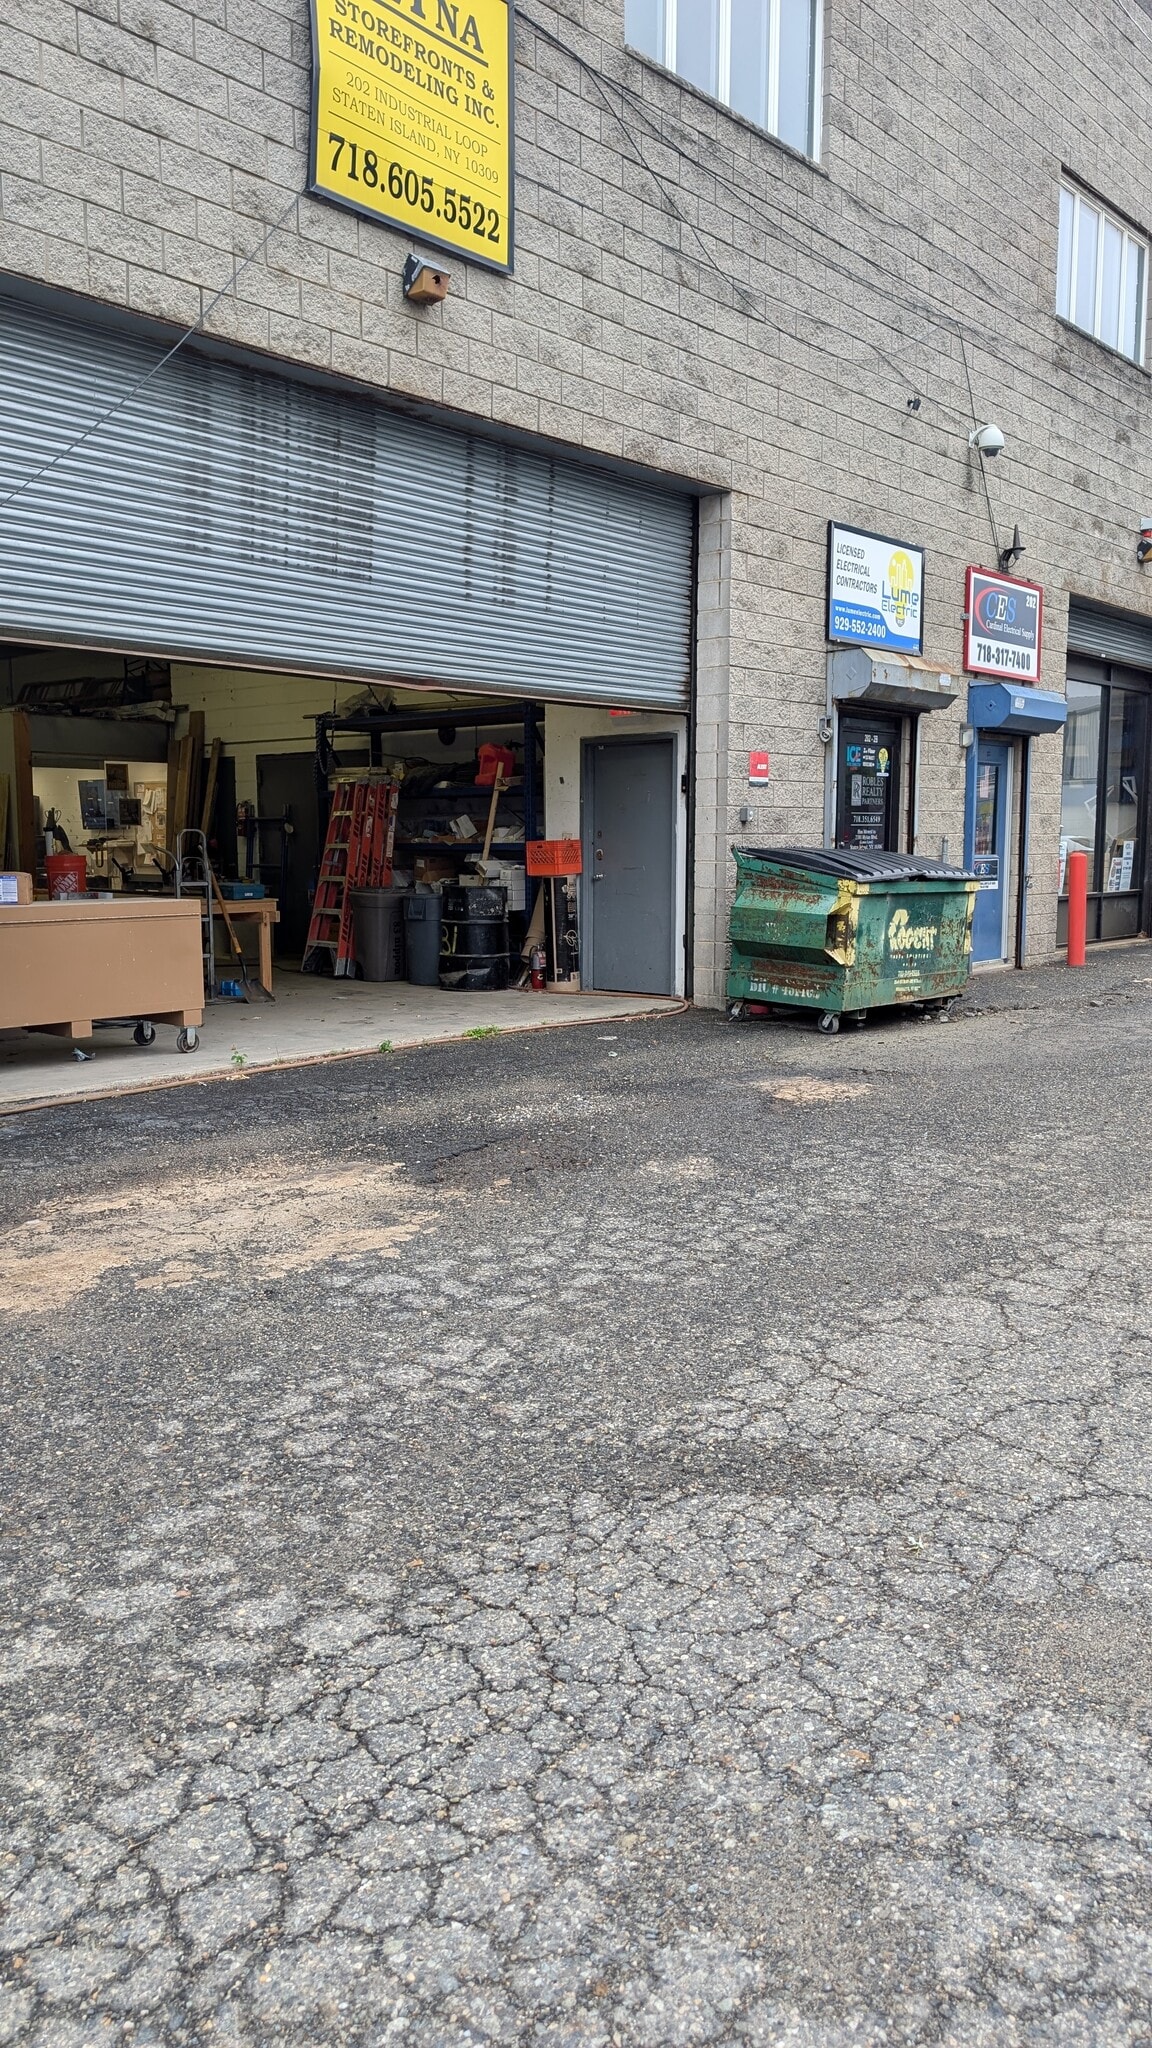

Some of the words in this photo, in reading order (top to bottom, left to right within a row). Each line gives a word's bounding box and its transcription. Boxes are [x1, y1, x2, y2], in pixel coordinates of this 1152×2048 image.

[335, 0, 476, 90] STOREFRONTS
[482, 80, 495, 101] &
[329, 17, 459, 107] REMODELING
[464, 94, 500, 128] INC.
[346, 71, 370, 96] 202
[375, 86, 452, 140] INDUSTRIAL
[455, 130, 488, 157] LOOP
[332, 87, 386, 126] STATEN
[390, 116, 440, 158] ISLAND,
[444, 145, 461, 165] NY
[466, 157, 499, 184] 10309
[328, 131, 500, 243] 718.605.5522
[836, 542, 865, 560] LICENSED
[836, 558, 871, 577] ELECTRICAL
[836, 575, 878, 594] CONTRACTORS
[881, 580, 920, 606] Lume
[881, 599, 918, 619] Electric
[986, 591, 1017, 623] CES
[1025, 595, 1037, 609] 202
[834, 615, 886, 639] 929-552-2400
[985, 619, 1004, 632] Cardinal
[1003, 623, 1022, 636] Electrical
[1021, 628, 1035, 641] Supply
[977, 642, 1031, 671] 718-317-7400
[862, 776, 884, 787] ROBLES
[862, 787, 884, 797] REALTY
[861, 798, 884, 806] PARTNERS
